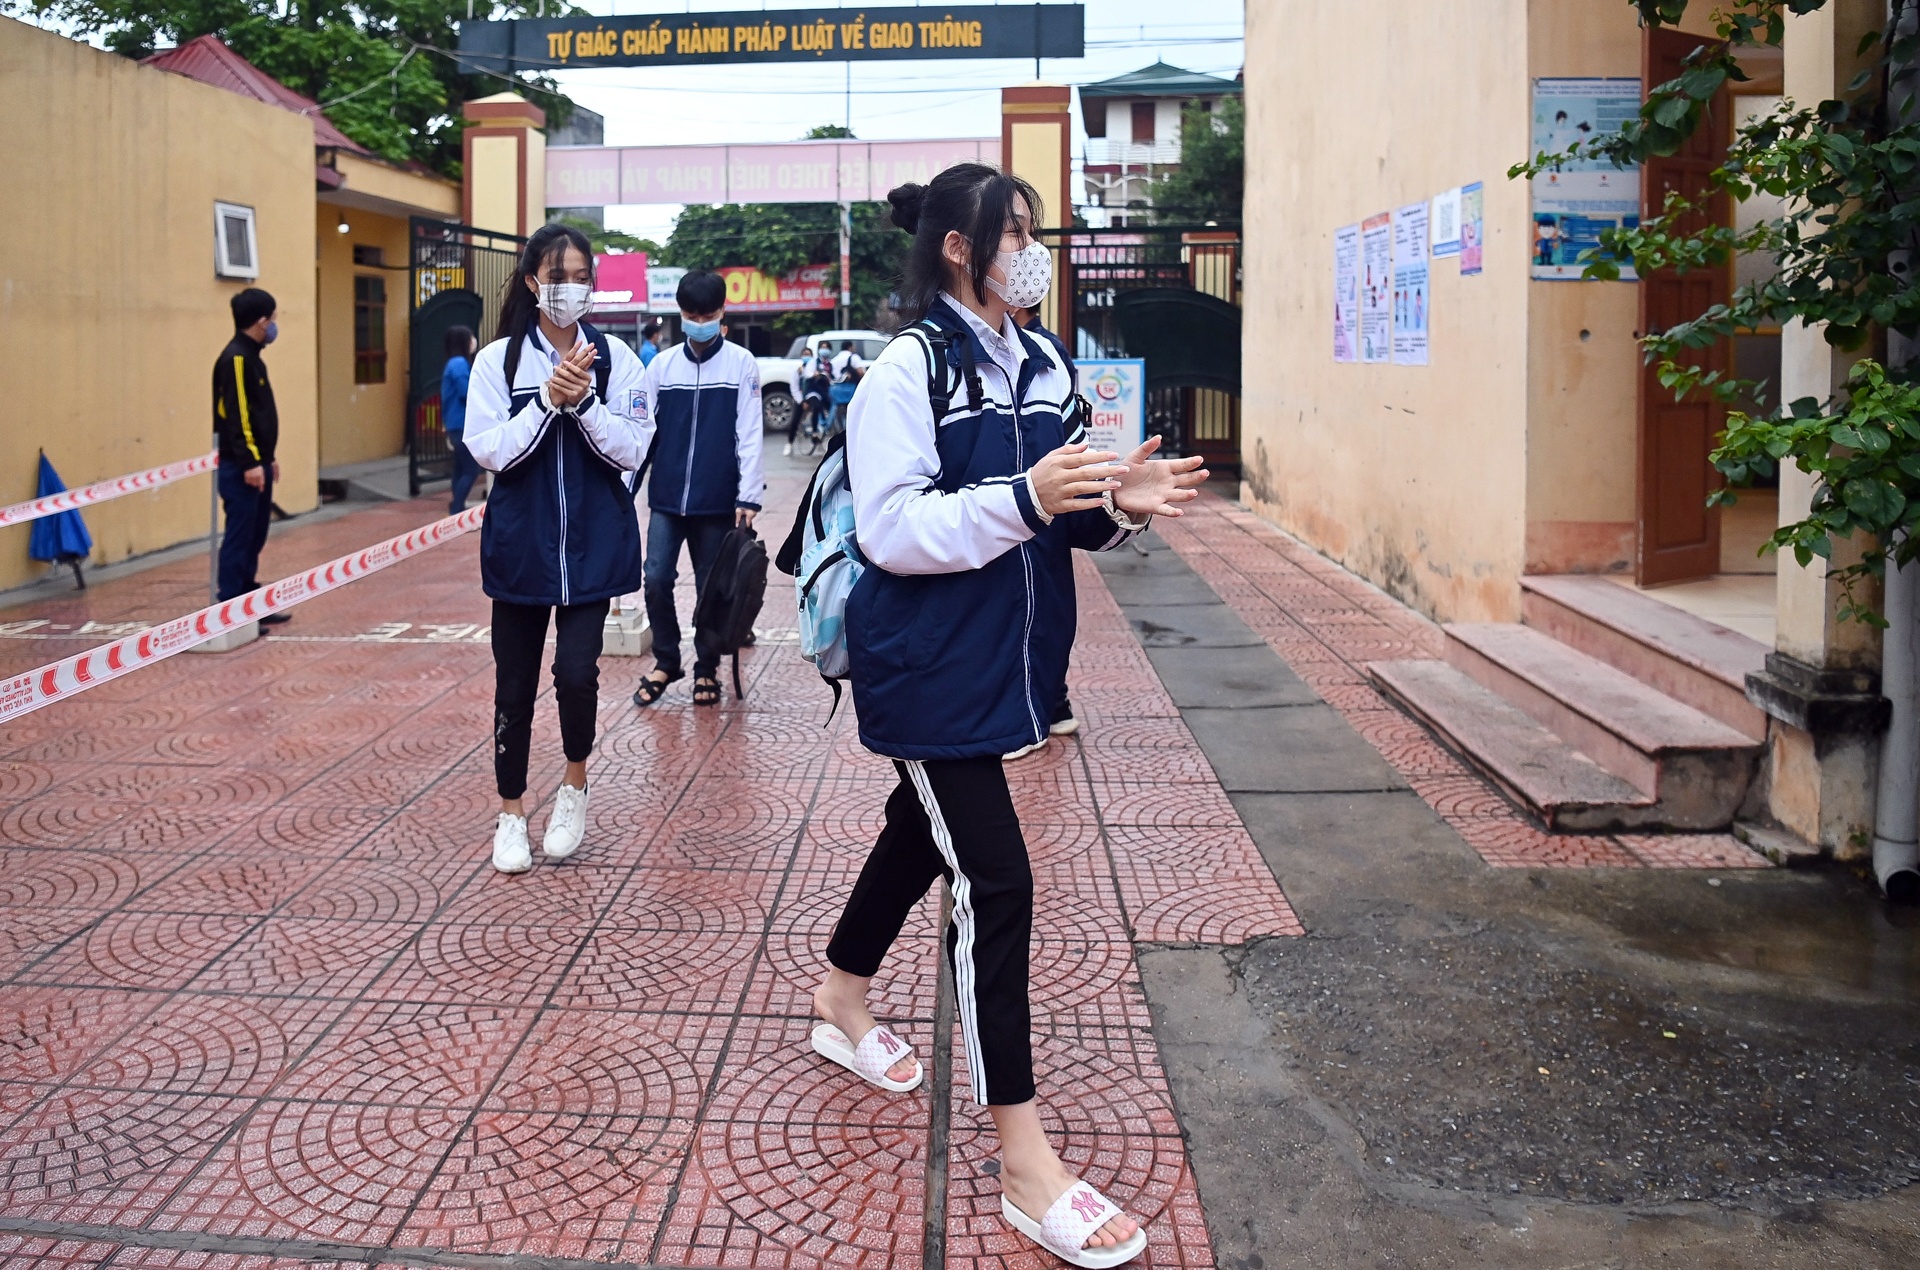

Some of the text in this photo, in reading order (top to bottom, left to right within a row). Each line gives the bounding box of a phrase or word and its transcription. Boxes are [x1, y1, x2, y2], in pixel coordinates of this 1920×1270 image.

[547, 30, 573, 64] TỰ
[575, 24, 618, 57] GIÁC
[622, 19, 673, 56] CHẤP
[677, 22, 730, 54] HÀNH
[733, 20, 787, 52] PHÁP
[791, 18, 836, 56] LUẬT
[869, 22, 914, 49] GIAO
[918, 14, 982, 48] THÔNG
[725, 271, 779, 303] ƠM
[1086, 413, 1123, 430] GHỊ
